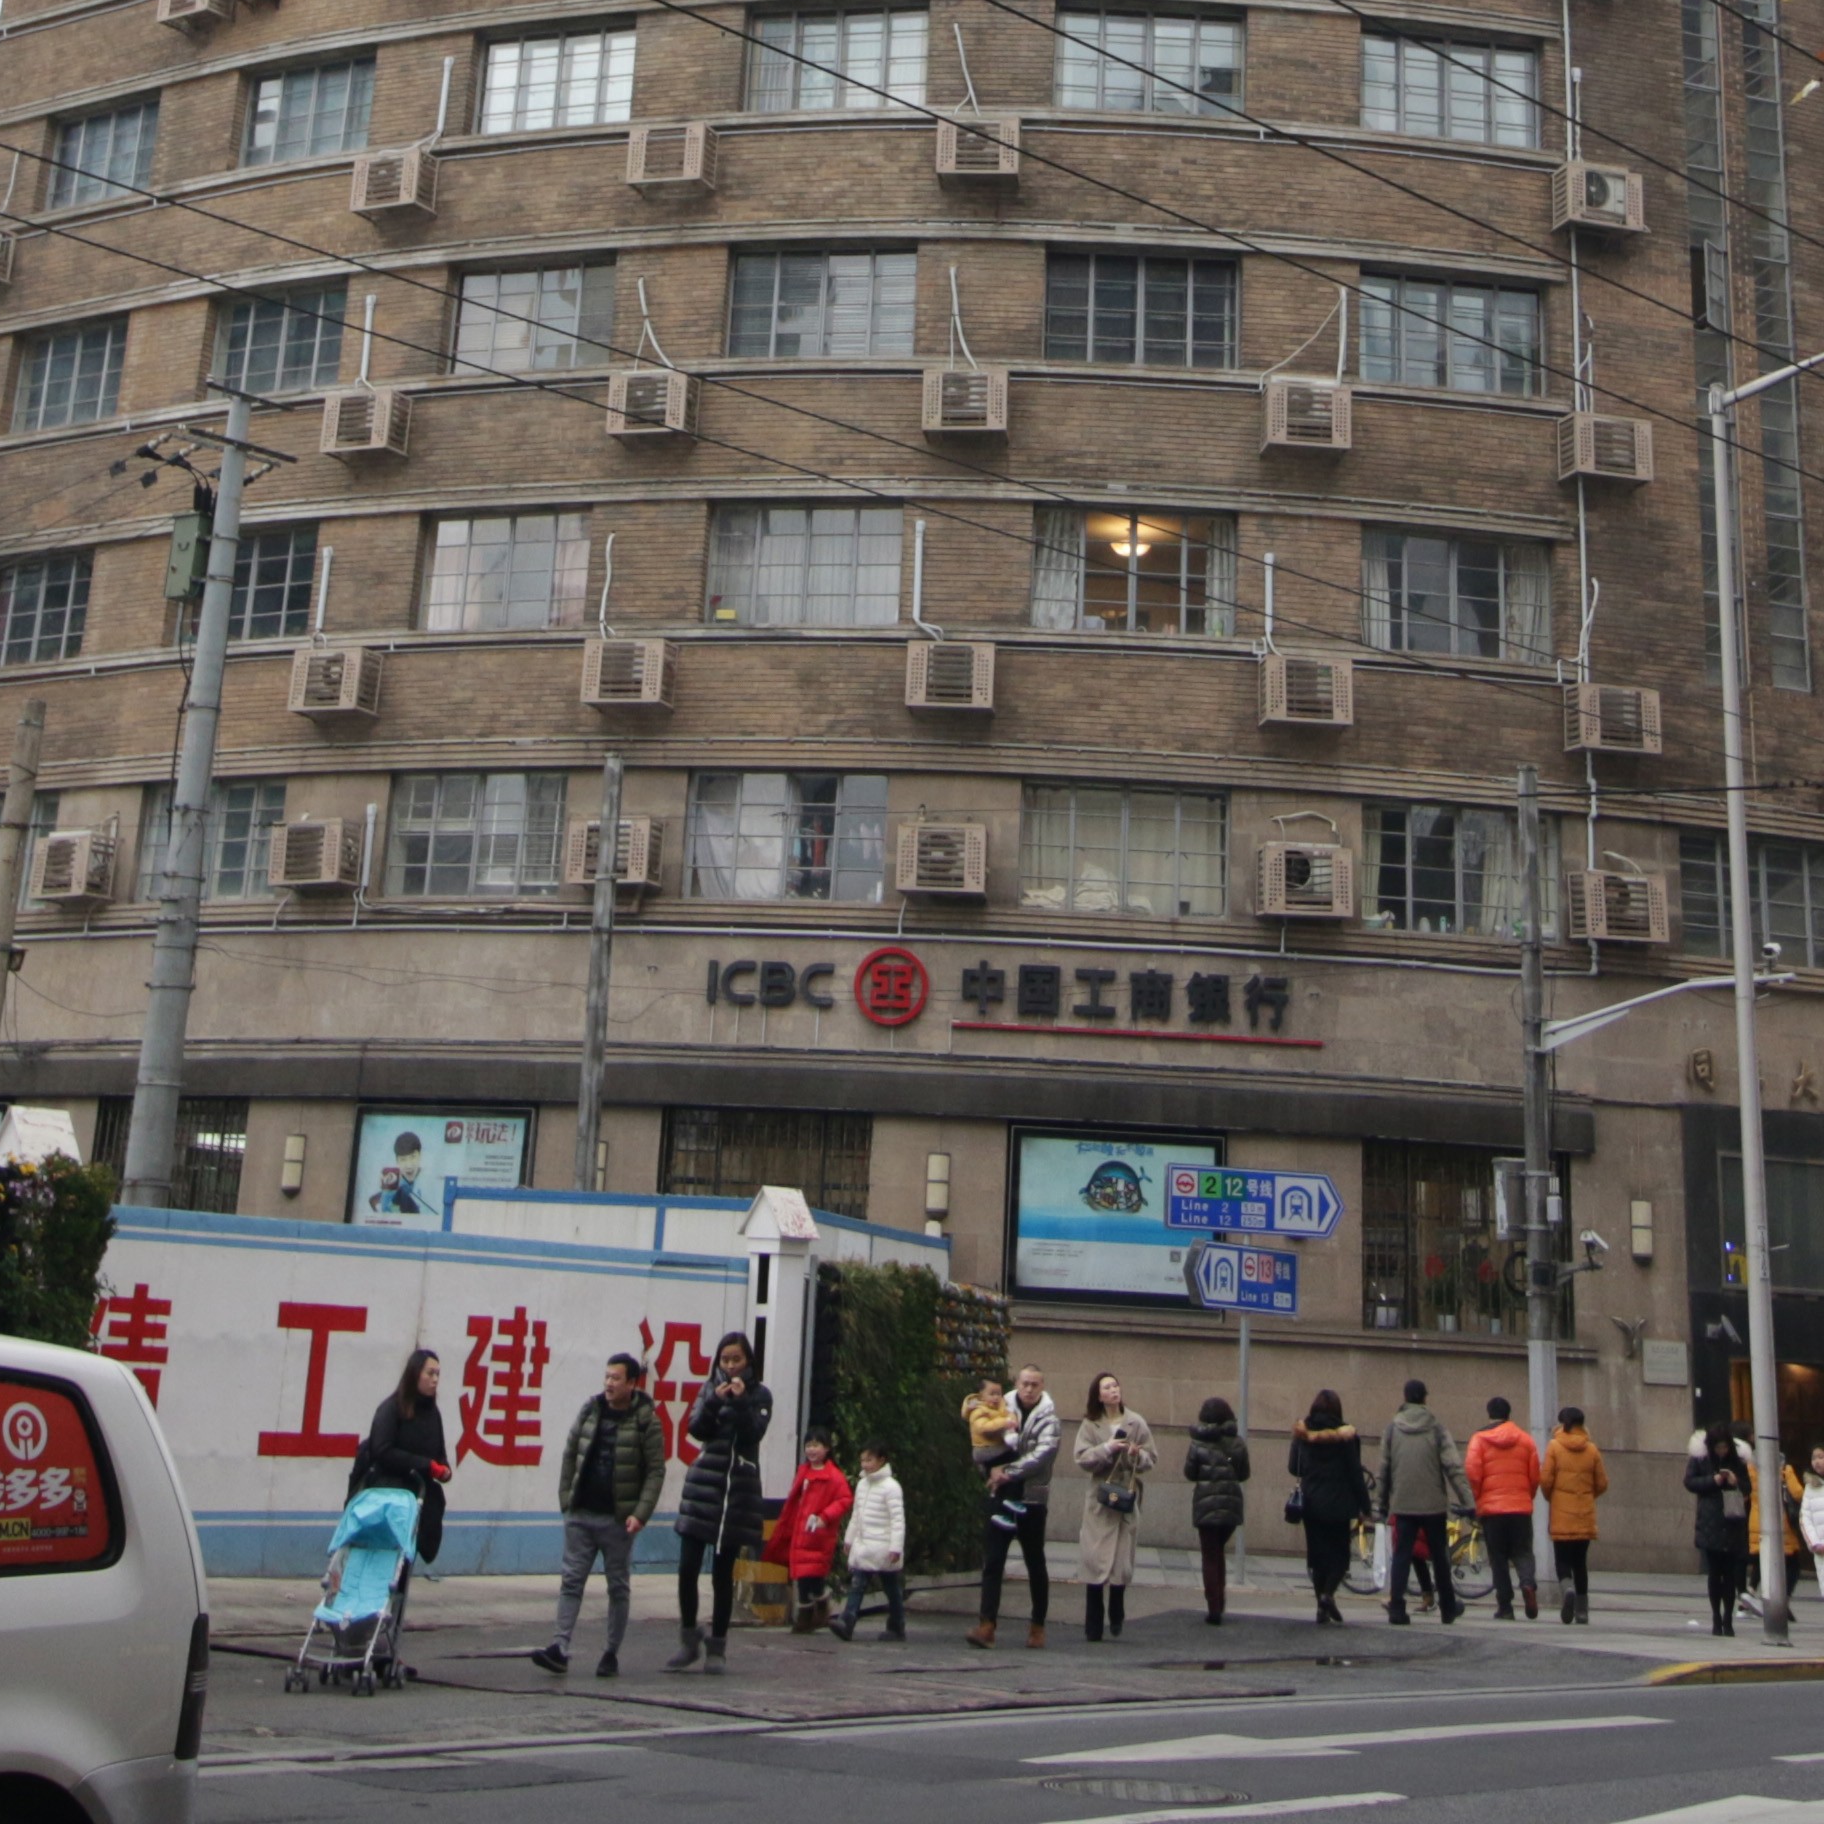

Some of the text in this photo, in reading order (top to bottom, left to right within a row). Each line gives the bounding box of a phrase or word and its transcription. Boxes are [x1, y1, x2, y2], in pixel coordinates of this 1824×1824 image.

[706, 959, 836, 1008] ICBC
[961, 959, 1291, 1030] 中国工商银行
[1204, 1175, 1273, 1199] 2 12 号线
[1181, 1199, 1209, 1212] Line
[1180, 1212, 1209, 1225] Line
[1219, 1214, 1232, 1227] 12
[1260, 1259, 1272, 1279] 13
